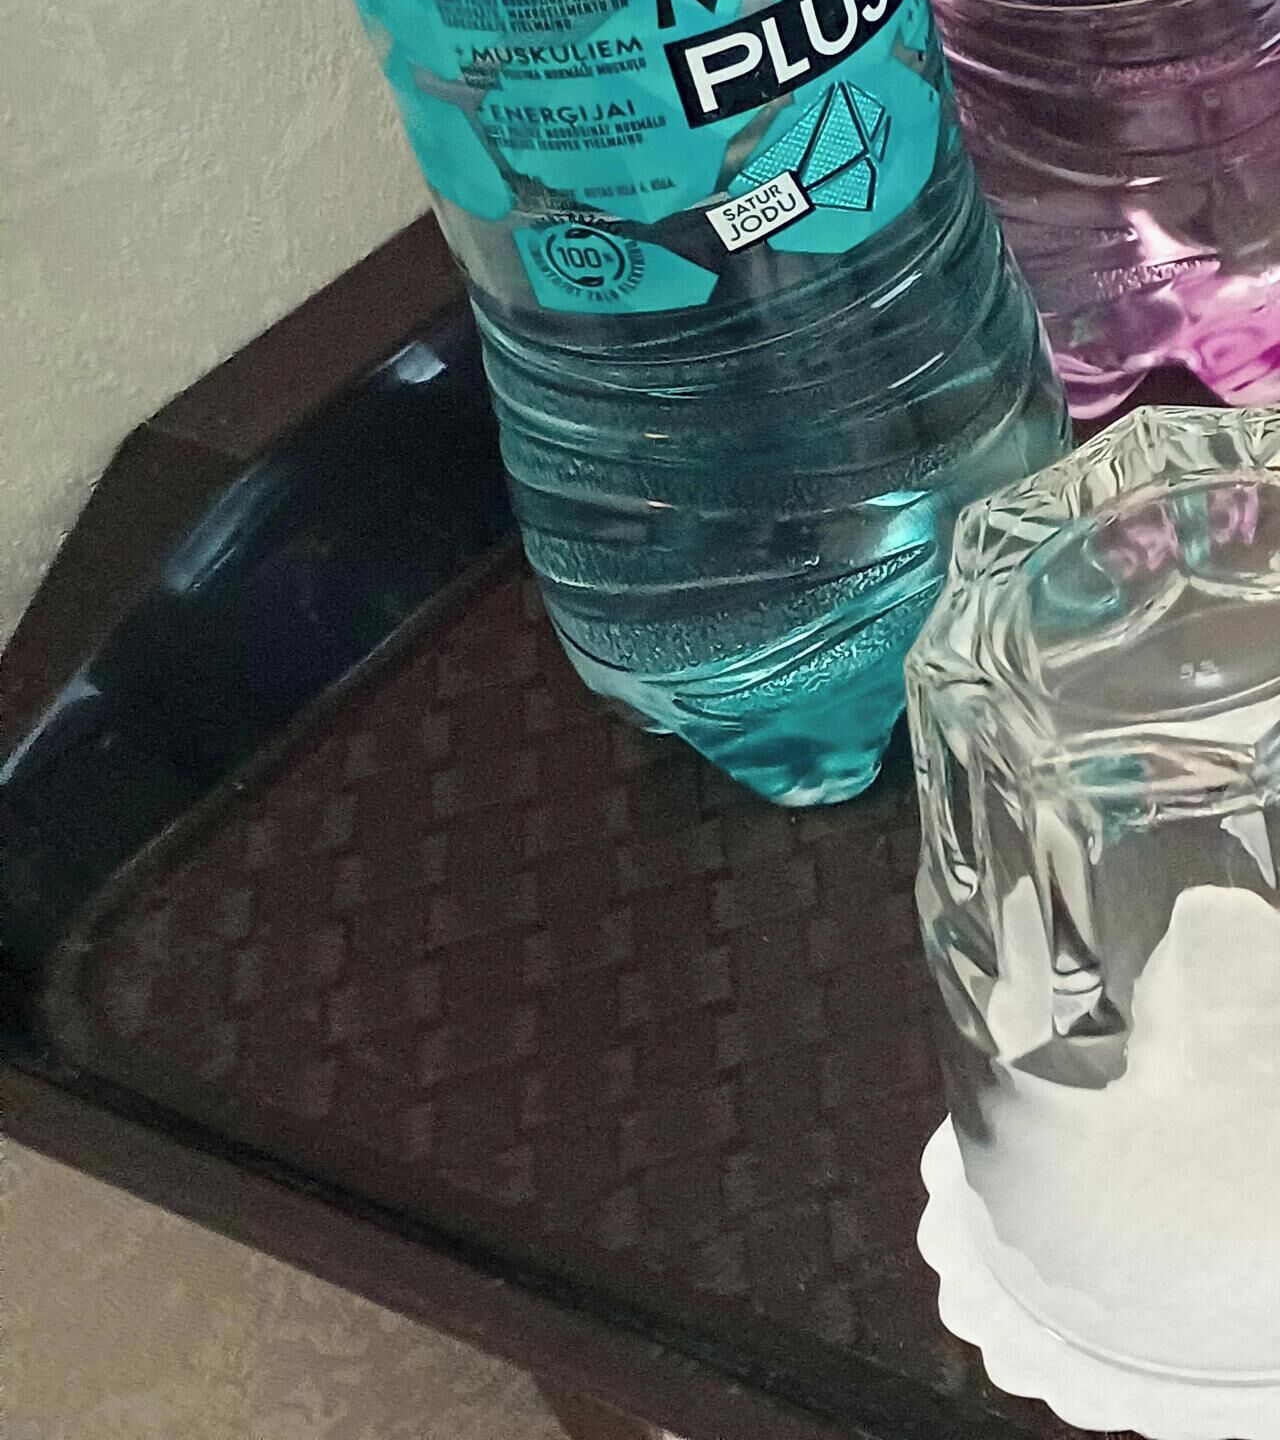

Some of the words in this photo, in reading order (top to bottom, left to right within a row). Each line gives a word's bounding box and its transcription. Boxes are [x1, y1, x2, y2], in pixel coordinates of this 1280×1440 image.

[471, 35, 644, 65] MUSKULIEM
[723, 184, 783, 222] SATUR
[730, 193, 797, 242] JODU
